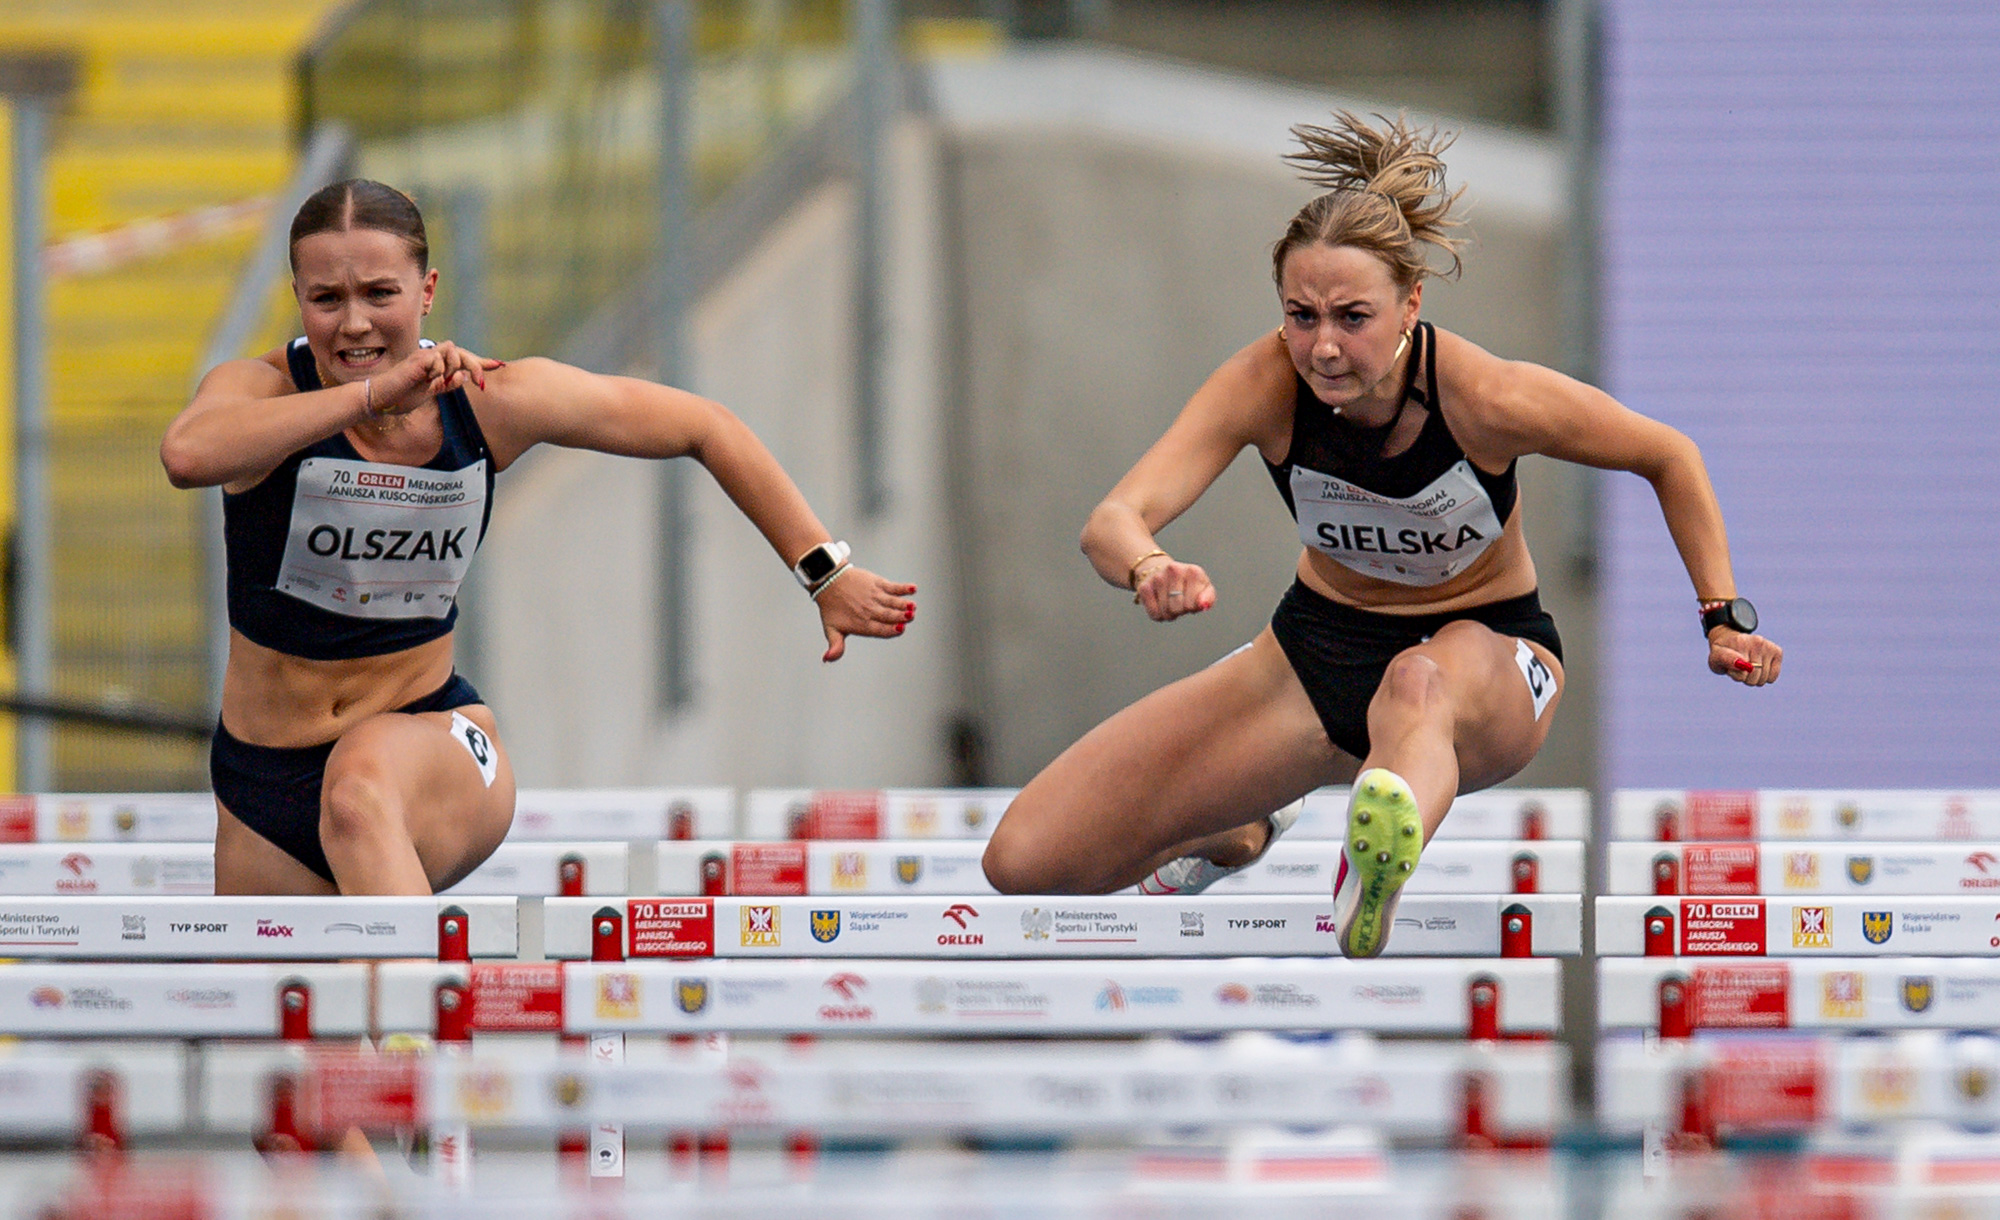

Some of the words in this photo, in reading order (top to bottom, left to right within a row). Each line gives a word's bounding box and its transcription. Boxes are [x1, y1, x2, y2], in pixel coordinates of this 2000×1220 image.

[333, 470, 354, 485] 70.
[359, 473, 403, 487] ORLEN
[408, 479, 463, 491] MEMORIAŁ
[327, 486, 375, 499] JANUSZA
[379, 490, 465, 505] KUSOCIŃSKIEGO
[1320, 491, 1370, 503] JANUSZA
[307, 523, 467, 561] OLSZAK
[1317, 522, 1485, 555] SIELSKA
[634, 904, 658, 918] 70.
[662, 906, 704, 915] ORLEN
[1055, 911, 1117, 920] Ministerstwo
[1687, 904, 1711, 919] 70.
[1715, 906, 1756, 916] ORLEN
[170, 923, 191, 932] TVP
[194, 923, 228, 932] SPORT
[1055, 923, 1087, 933] Sportu
[1095, 923, 1138, 934] Turystyki
[1228, 919, 1250, 928] TVP
[1252, 919, 1287, 928] SPORT
[37, 925, 79, 937] Turystyki
[634, 931, 675, 940] JANUSZA
[743, 933, 778, 944] PZLA
[937, 934, 984, 945] ORLEN
[1794, 935, 1831, 946] PZLA
